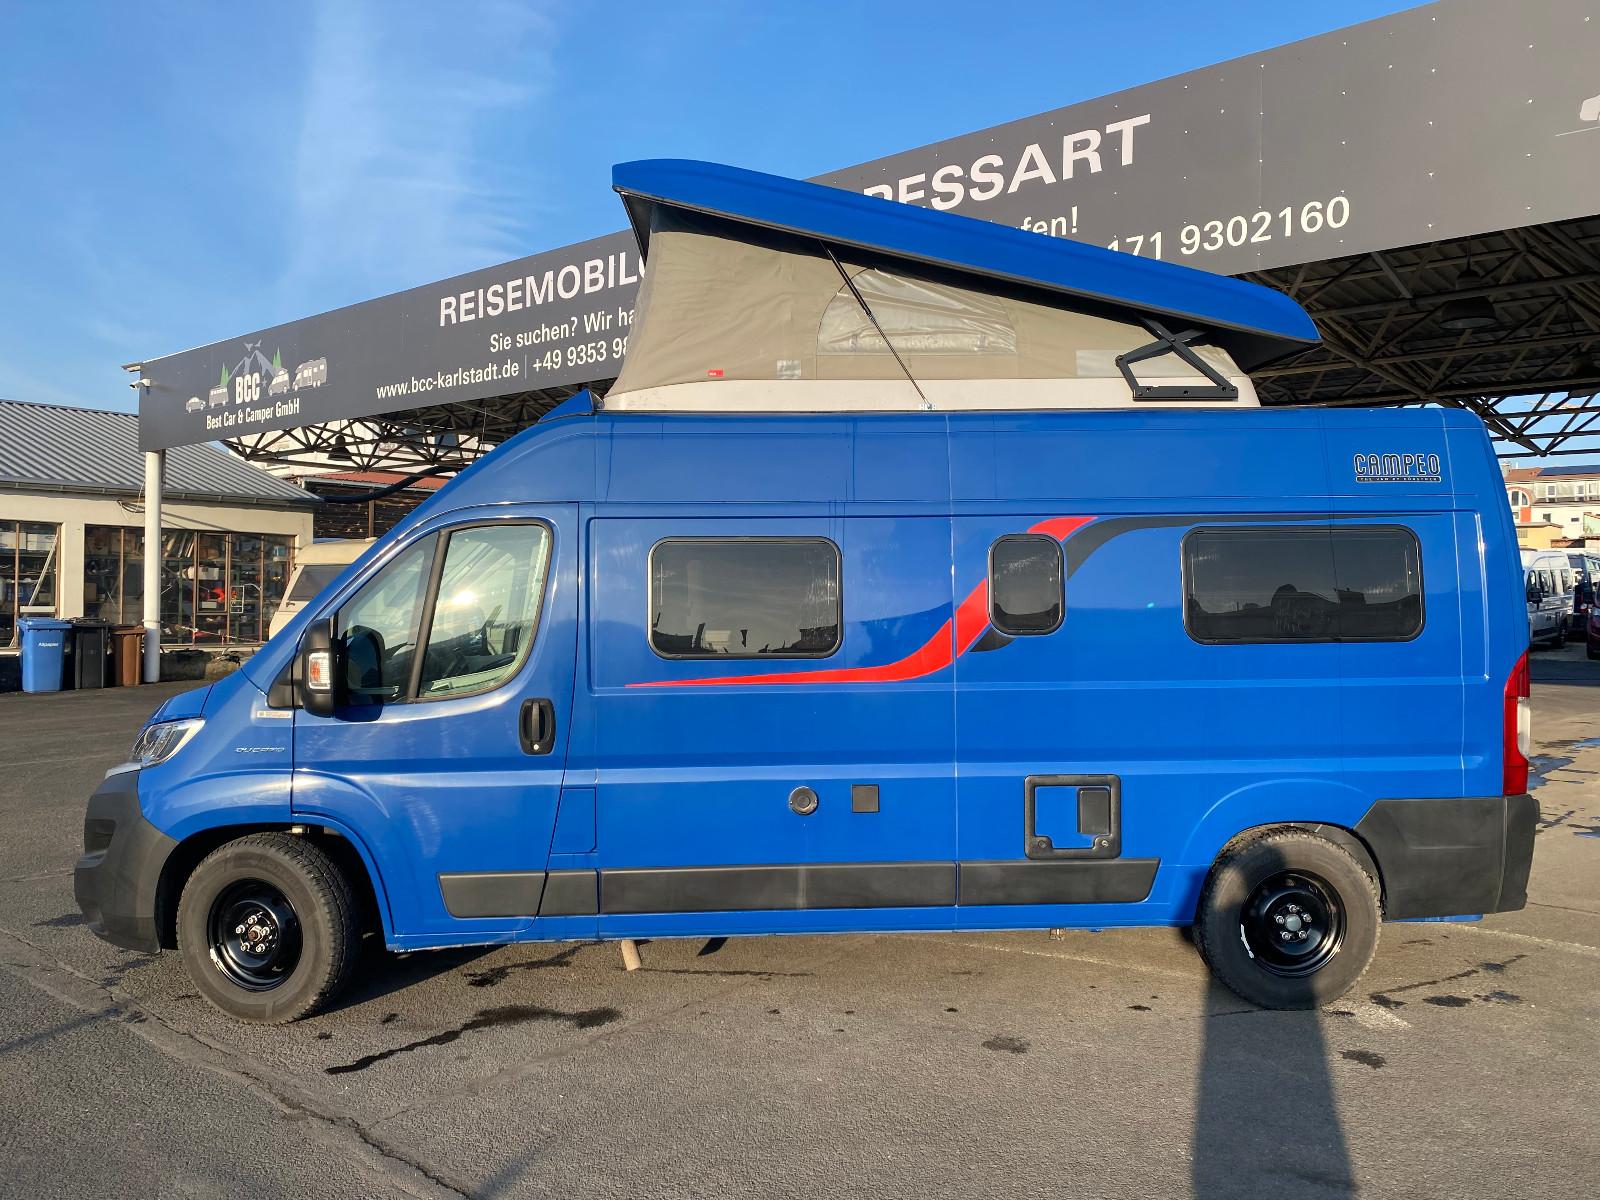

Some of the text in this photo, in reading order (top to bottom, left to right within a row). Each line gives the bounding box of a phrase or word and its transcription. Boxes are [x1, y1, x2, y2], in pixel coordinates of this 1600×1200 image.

[376, 358, 520, 399] www.bcc-karlstadt.de
[532, 349, 562, 373] +49
[567, 340, 607, 368] 9353
[1180, 196, 1350, 255] 9302160
[438, 251, 646, 327] REISEMOBIL
[489, 333, 512, 353] Sie
[515, 316, 578, 348] suchen?
[583, 309, 613, 334] Wir
[235, 371, 260, 405] BCC
[206, 397, 300, 430] Best Car & Camper GmbH
[1353, 453, 1440, 475] CAMPEO
